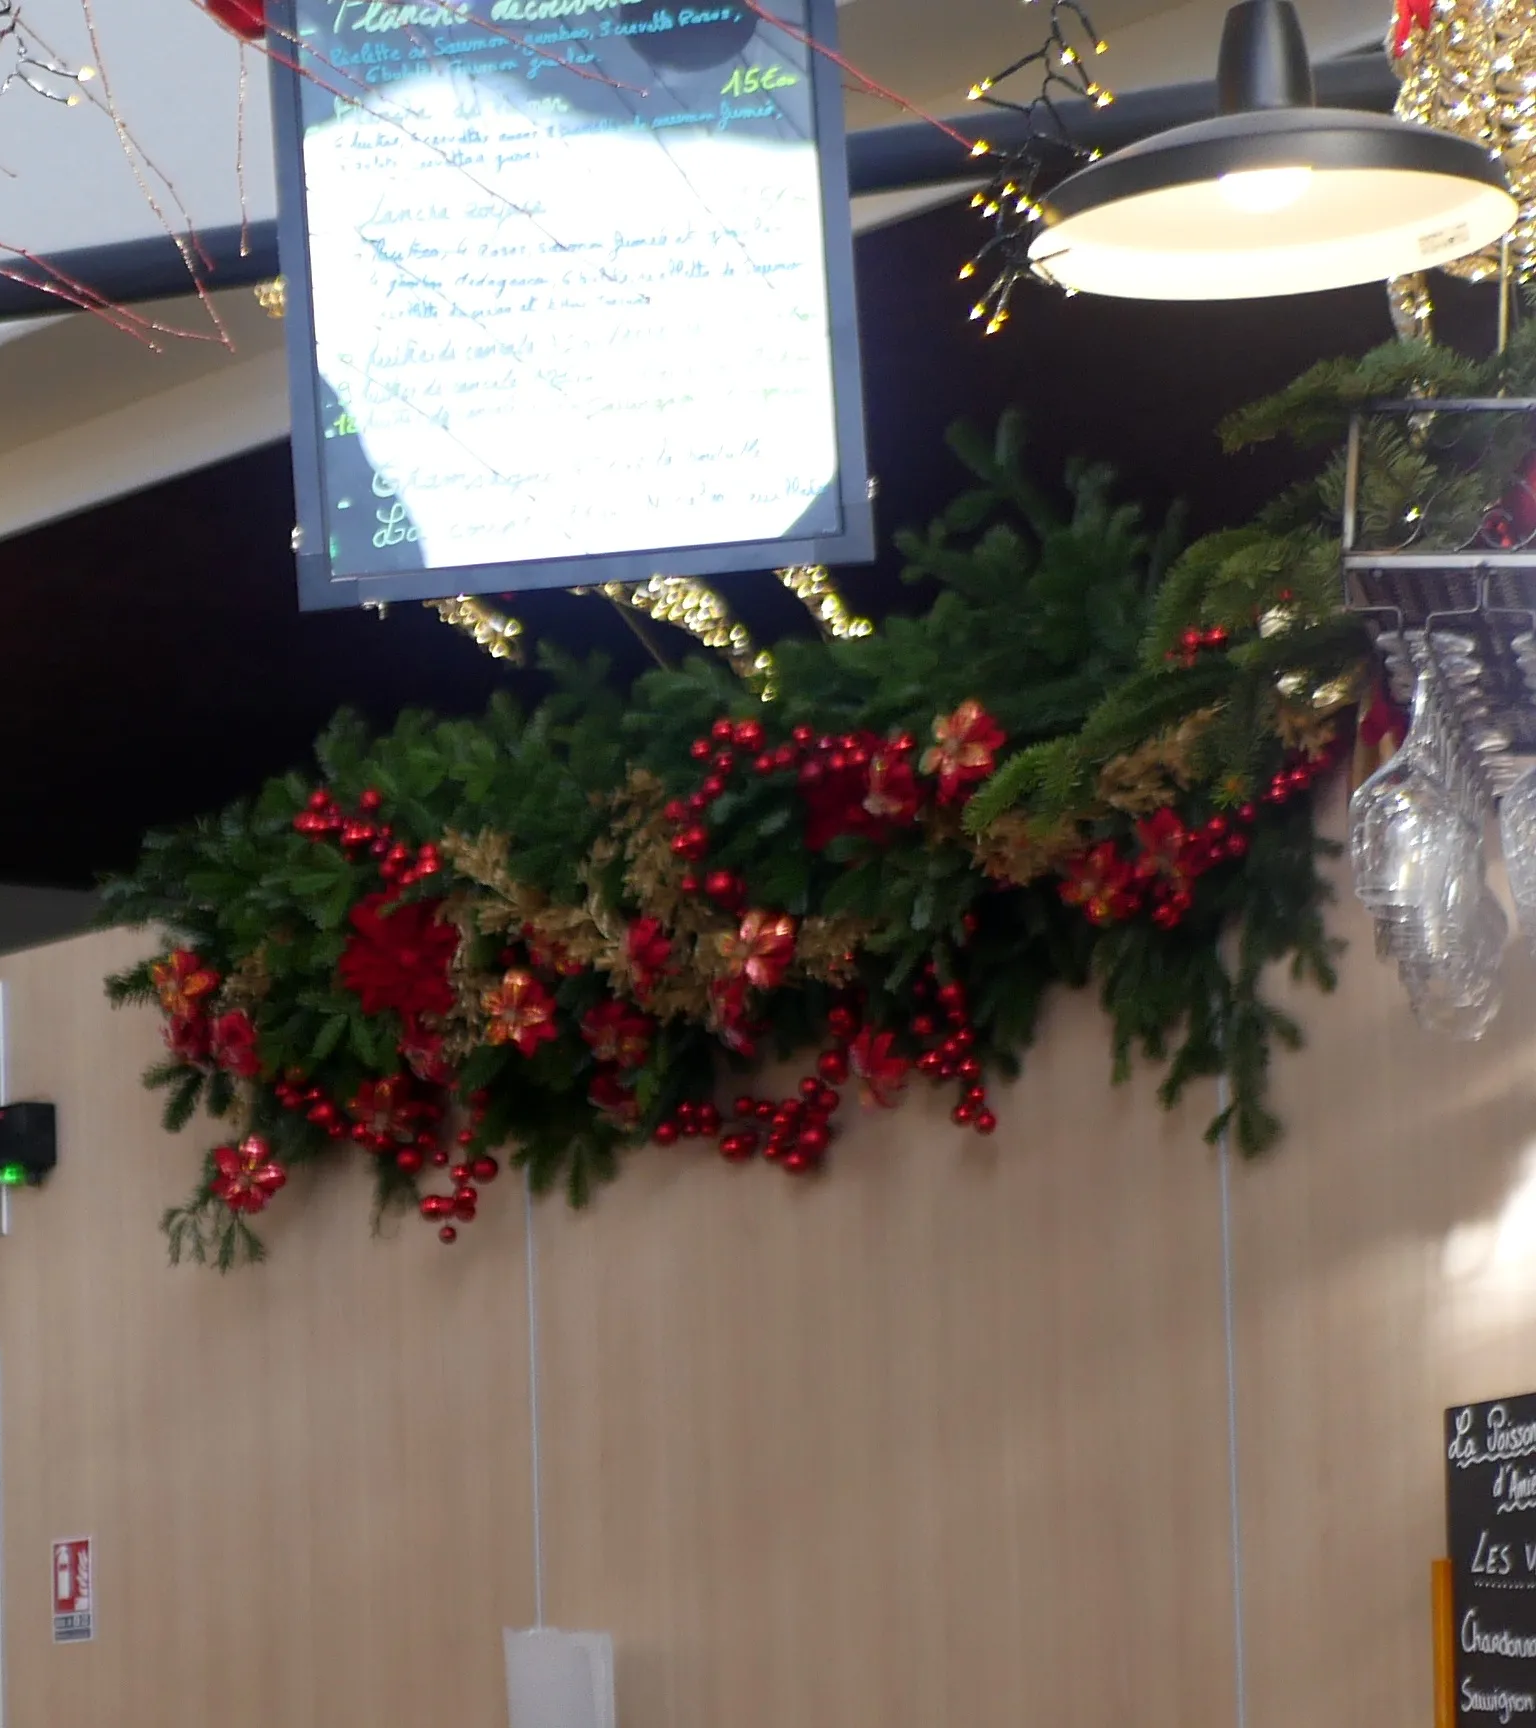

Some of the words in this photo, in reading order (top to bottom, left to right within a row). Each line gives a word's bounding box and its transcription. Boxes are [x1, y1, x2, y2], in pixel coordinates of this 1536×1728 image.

[1448, 1408, 1476, 1460] La
[1470, 1528, 1512, 1576] LES
[1460, 1676, 1535, 1726] Sauvignon
